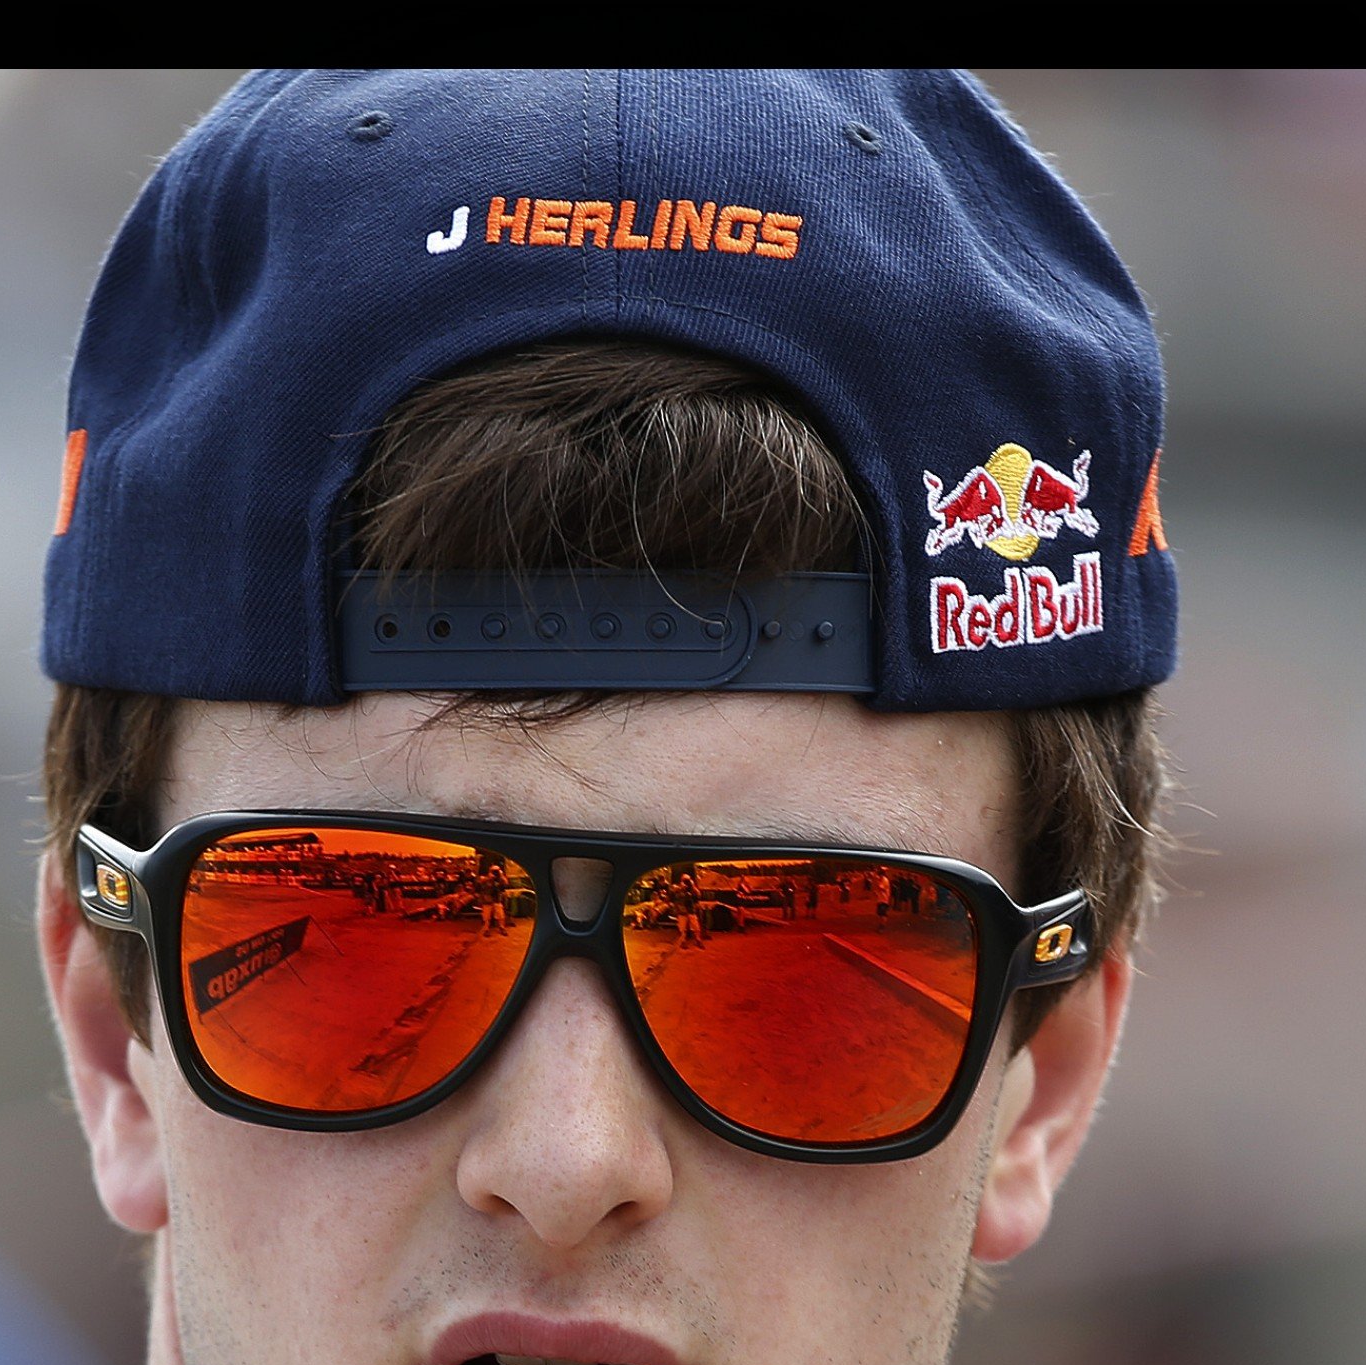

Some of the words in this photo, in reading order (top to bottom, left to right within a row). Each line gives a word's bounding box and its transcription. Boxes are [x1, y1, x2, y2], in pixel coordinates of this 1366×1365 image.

[426, 205, 470, 254] J
[485, 196, 804, 260] HERLINGS
[932, 568, 1023, 653] Red
[1024, 552, 1102, 643] Bull
